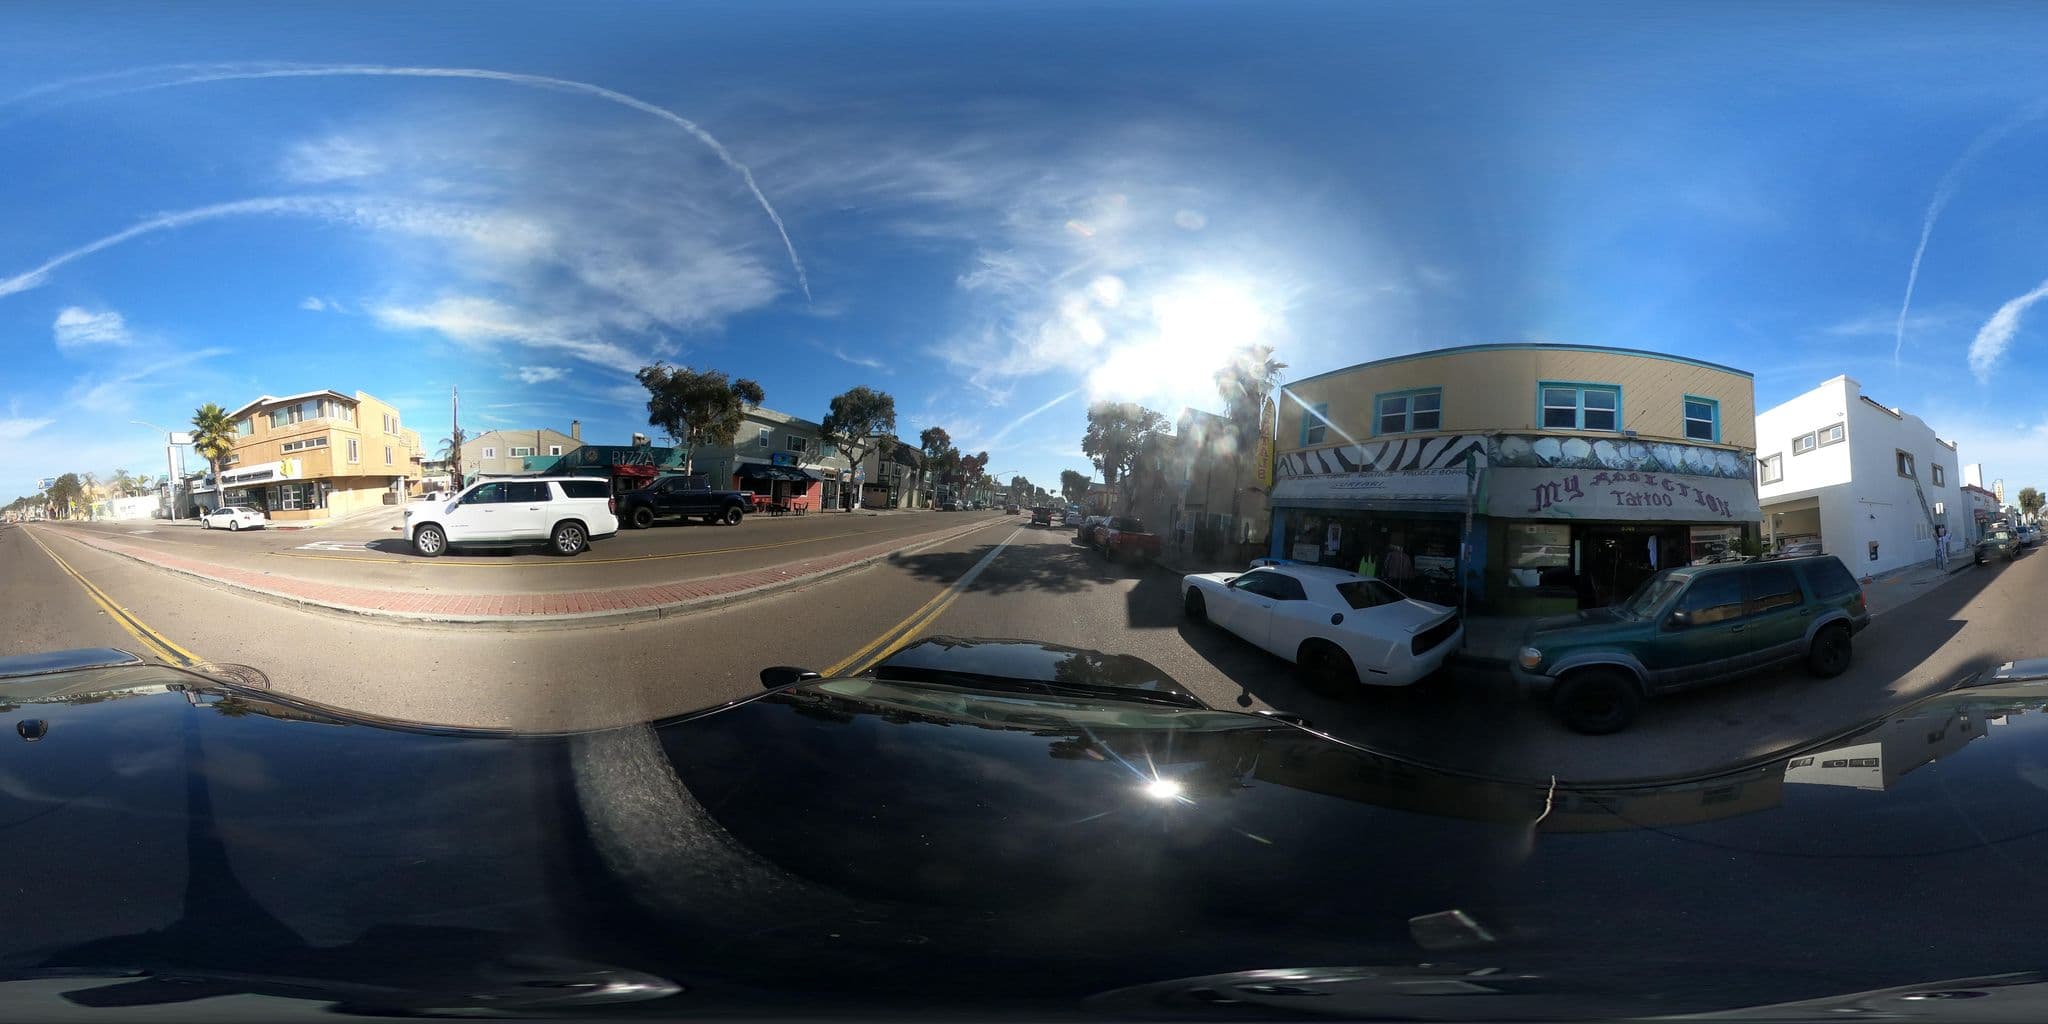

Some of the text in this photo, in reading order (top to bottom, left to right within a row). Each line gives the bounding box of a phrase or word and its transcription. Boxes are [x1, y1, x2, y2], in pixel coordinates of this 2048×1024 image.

[612, 450, 655, 466] PIZZA
[1590, 471, 1733, 518] ADDICTION
[1610, 490, 1673, 507] Tattoo
